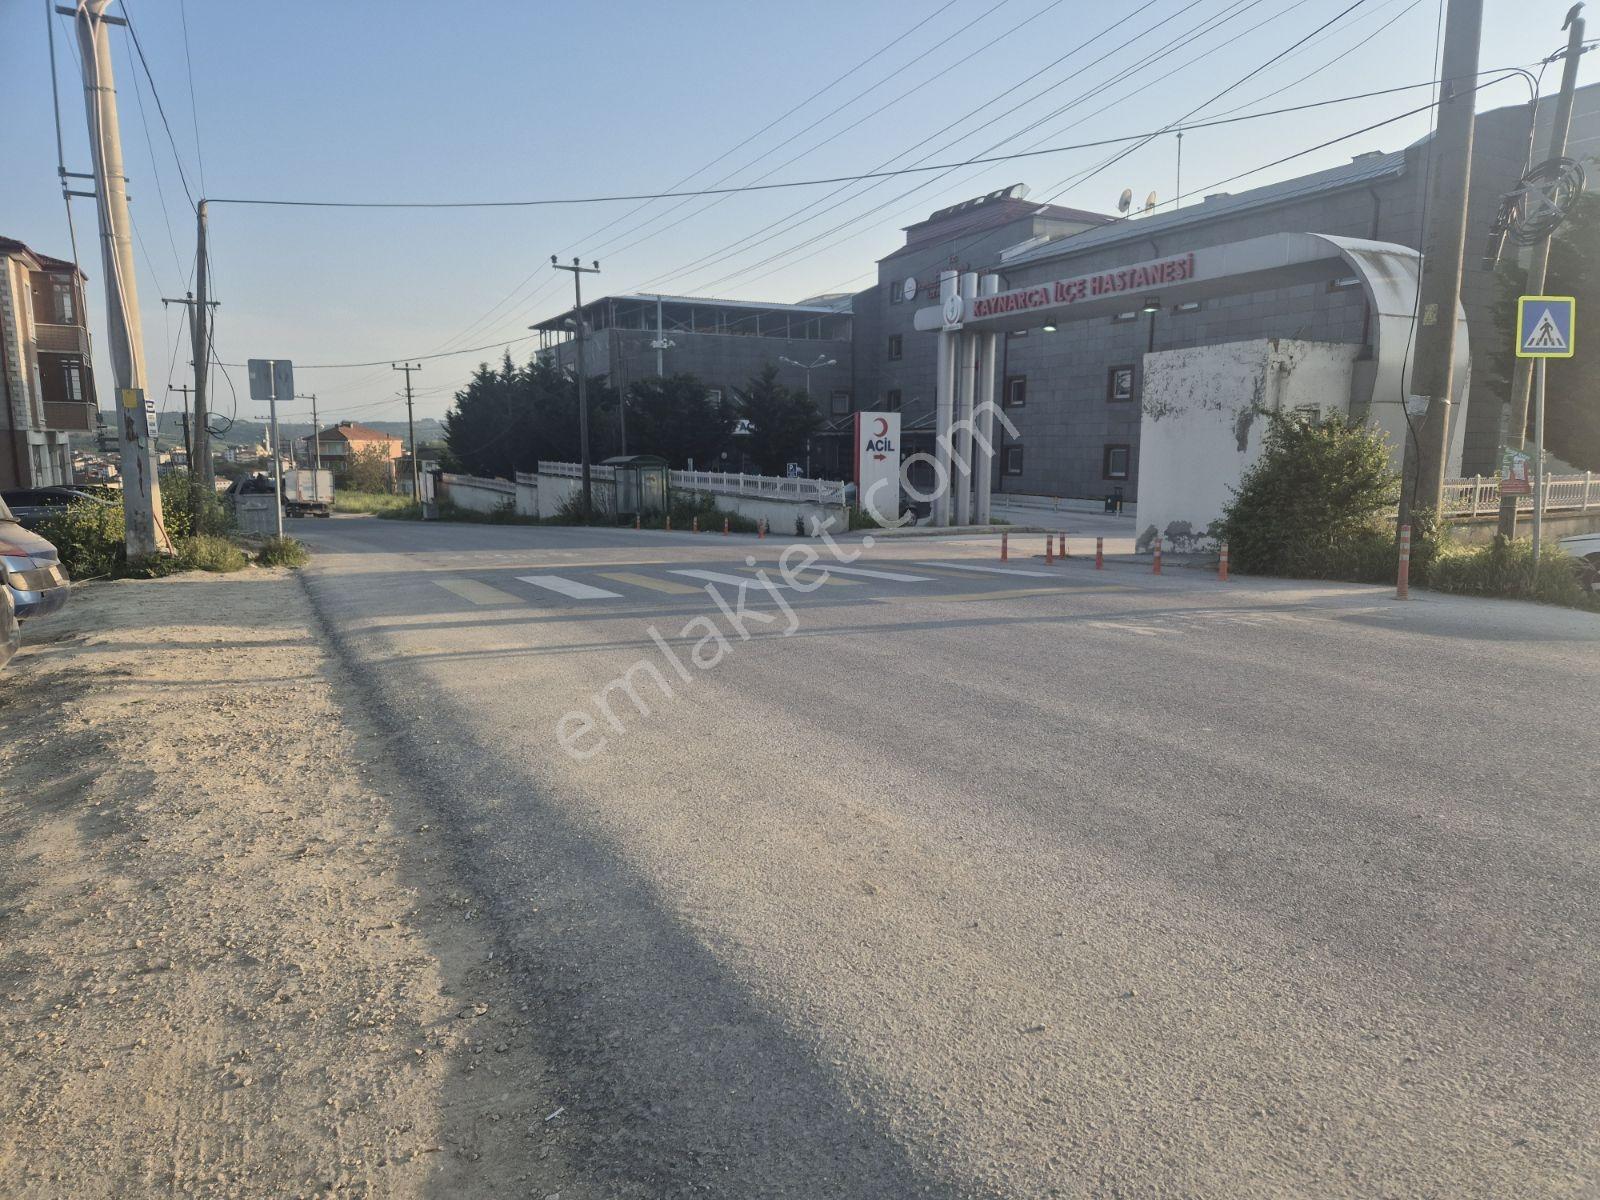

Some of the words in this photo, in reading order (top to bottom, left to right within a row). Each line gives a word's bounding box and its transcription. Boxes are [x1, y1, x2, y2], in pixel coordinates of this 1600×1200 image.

[973, 288, 1050, 317] KAYNARCA
[1054, 281, 1086, 303] İLÇE
[1090, 252, 1195, 296] HASTANESİ
[865, 437, 895, 452] ACİL
